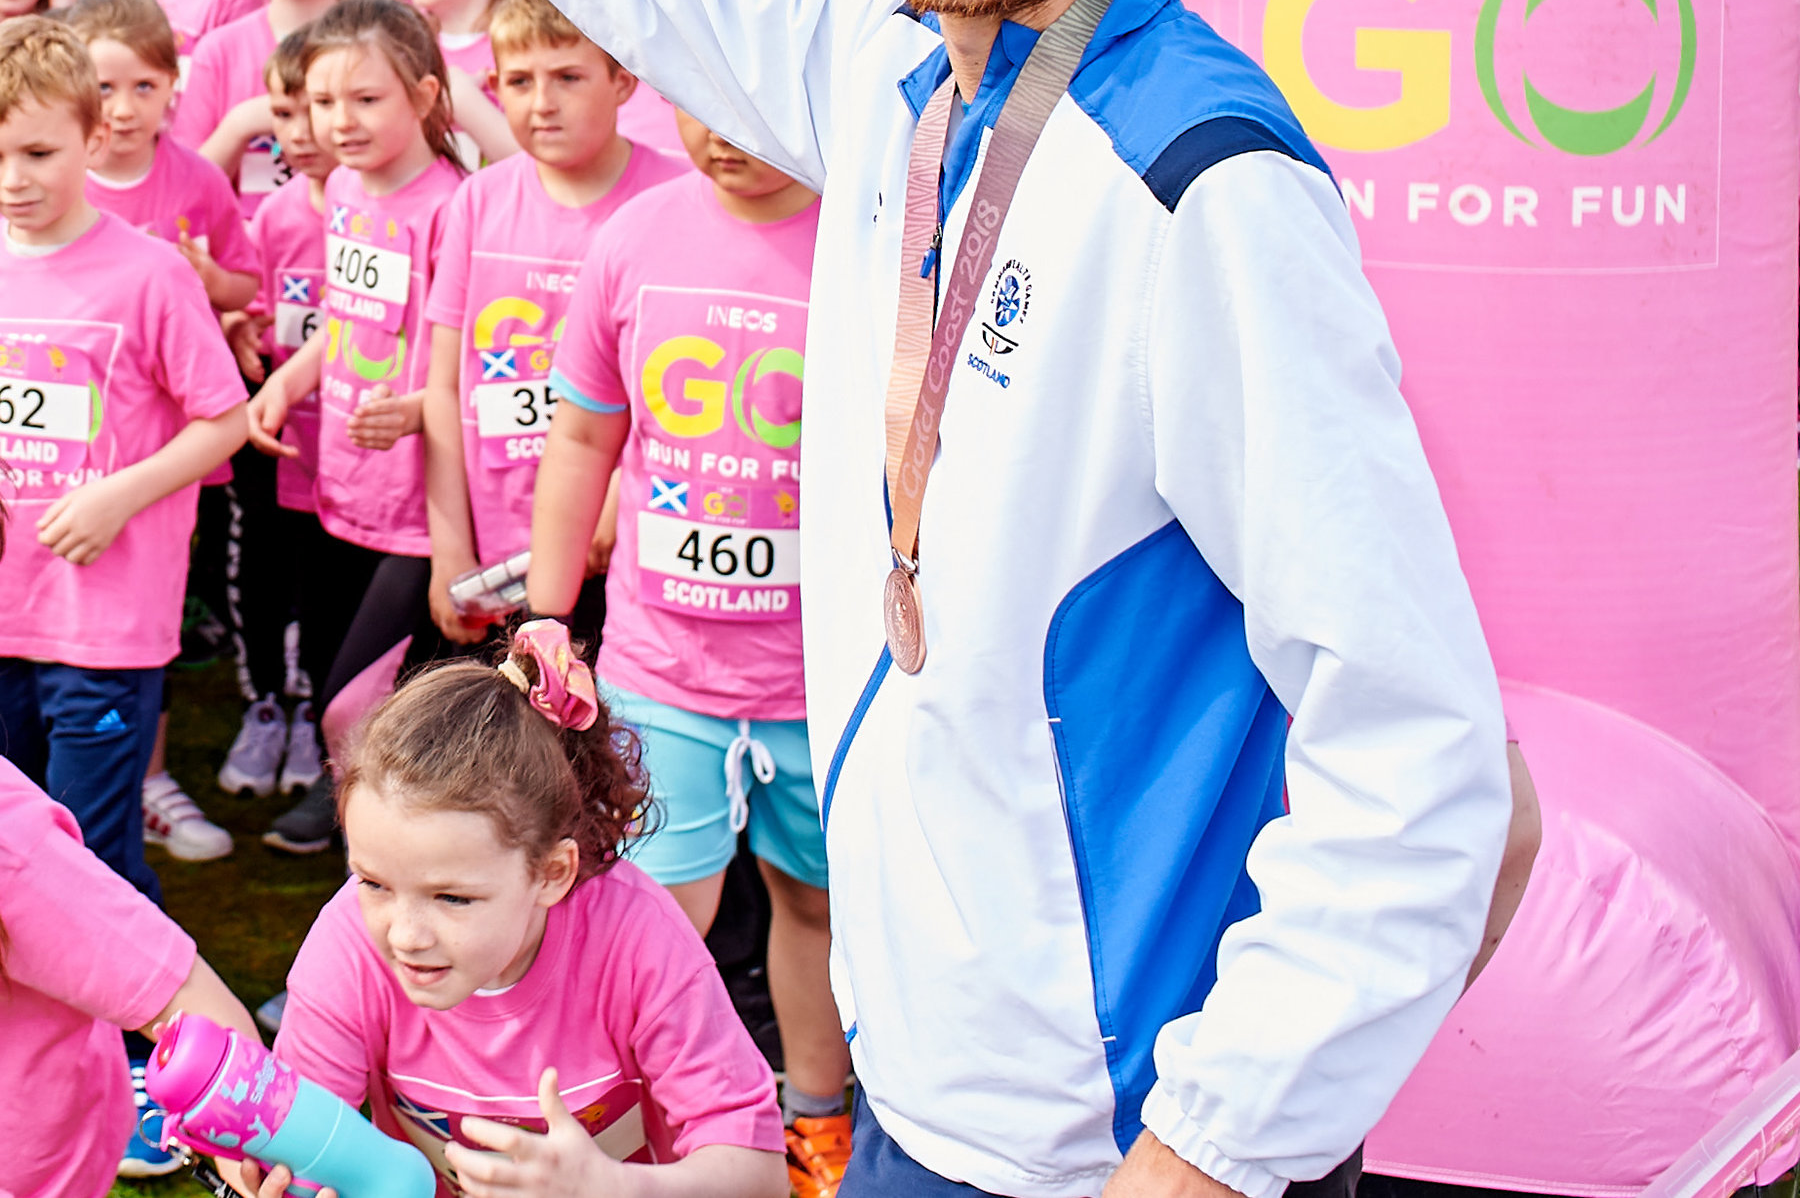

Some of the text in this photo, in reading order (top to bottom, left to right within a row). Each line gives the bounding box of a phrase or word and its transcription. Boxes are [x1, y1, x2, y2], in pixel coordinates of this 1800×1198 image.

[1407, 182, 1539, 228] FOR
[1571, 183, 1687, 228] FUN
[959, 198, 1001, 285] 2018
[334, 245, 378, 290] 406
[706, 305, 777, 333] INEOS
[641, 335, 805, 449] GO
[966, 352, 1011, 389] SCOTLAND
[649, 437, 691, 470] RUN
[701, 452, 759, 480] FOR
[677, 528, 775, 579] 460
[662, 578, 791, 613] SCOTLAND
